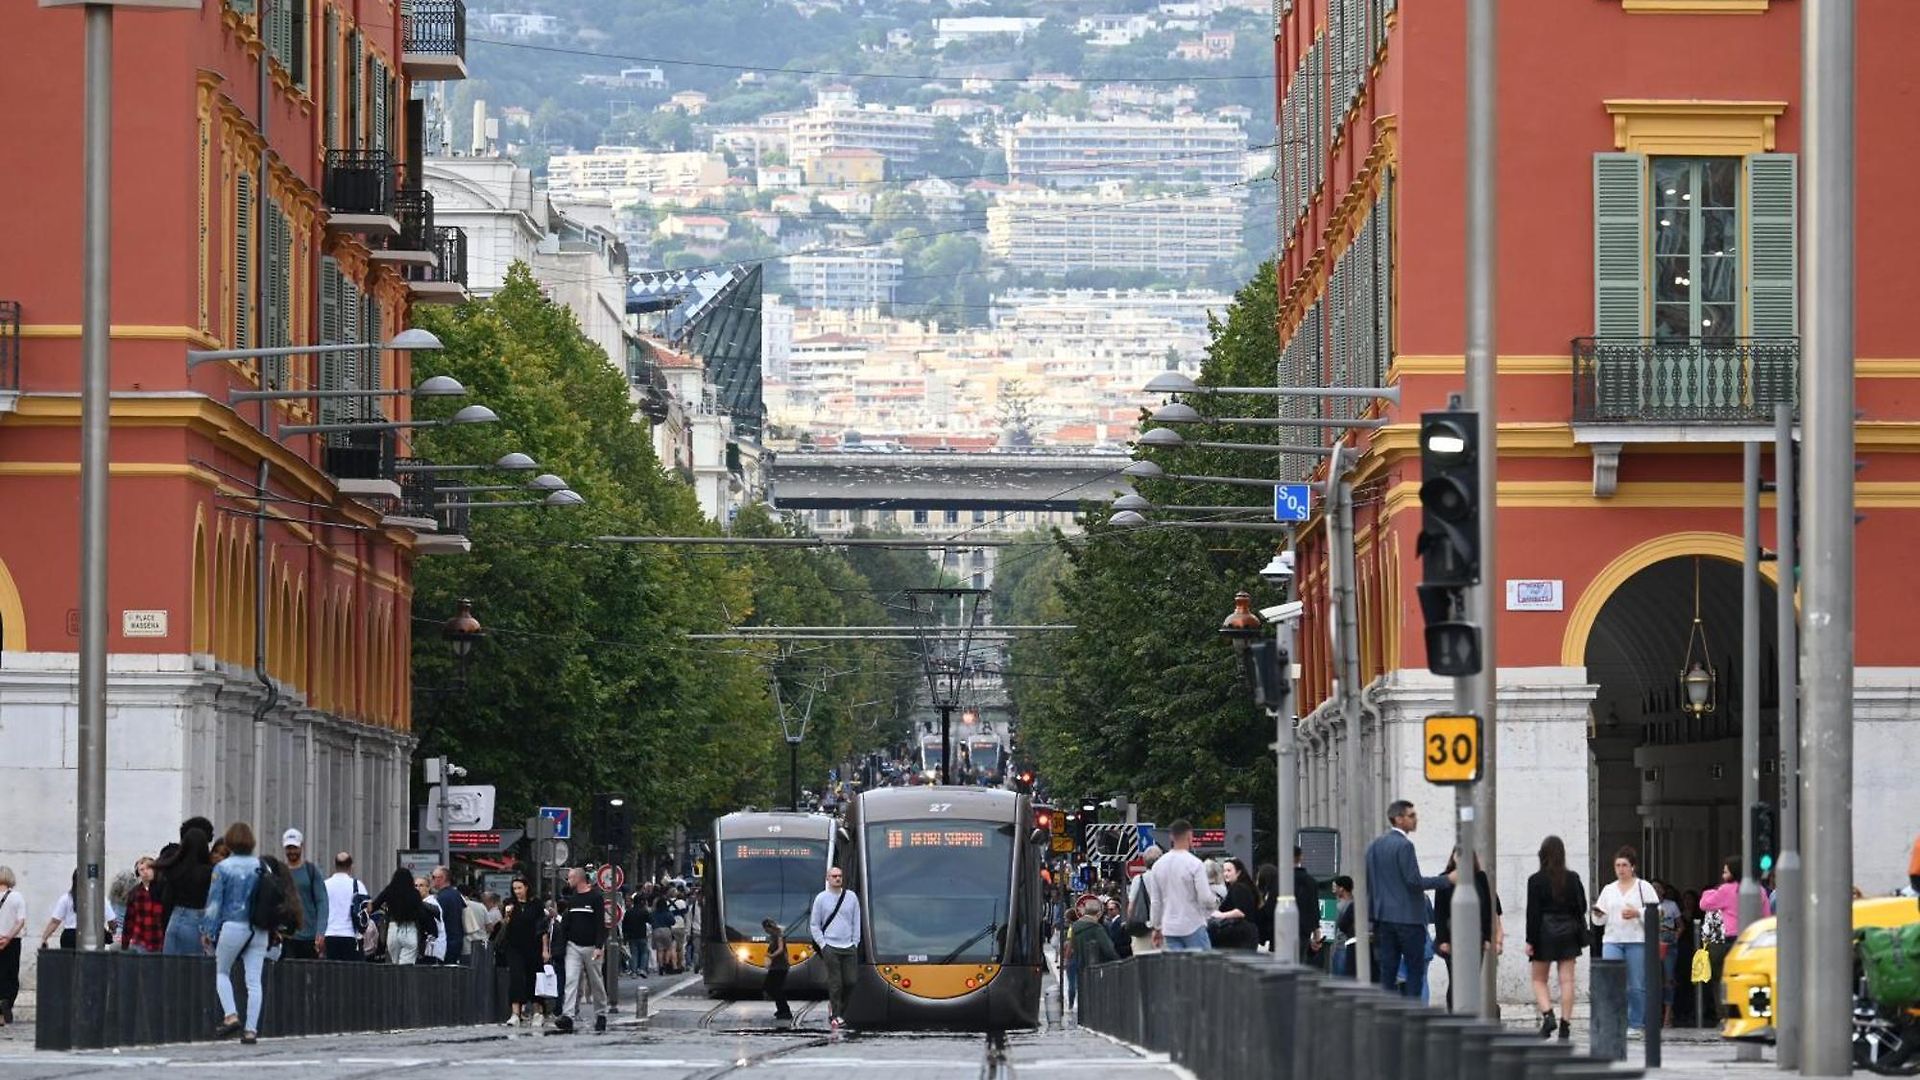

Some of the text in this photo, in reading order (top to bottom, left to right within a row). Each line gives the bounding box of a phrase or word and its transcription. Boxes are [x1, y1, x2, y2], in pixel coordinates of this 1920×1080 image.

[1278, 486, 1306, 519] SOS
[1428, 733, 1473, 766] 30
[929, 803, 952, 813] 27
